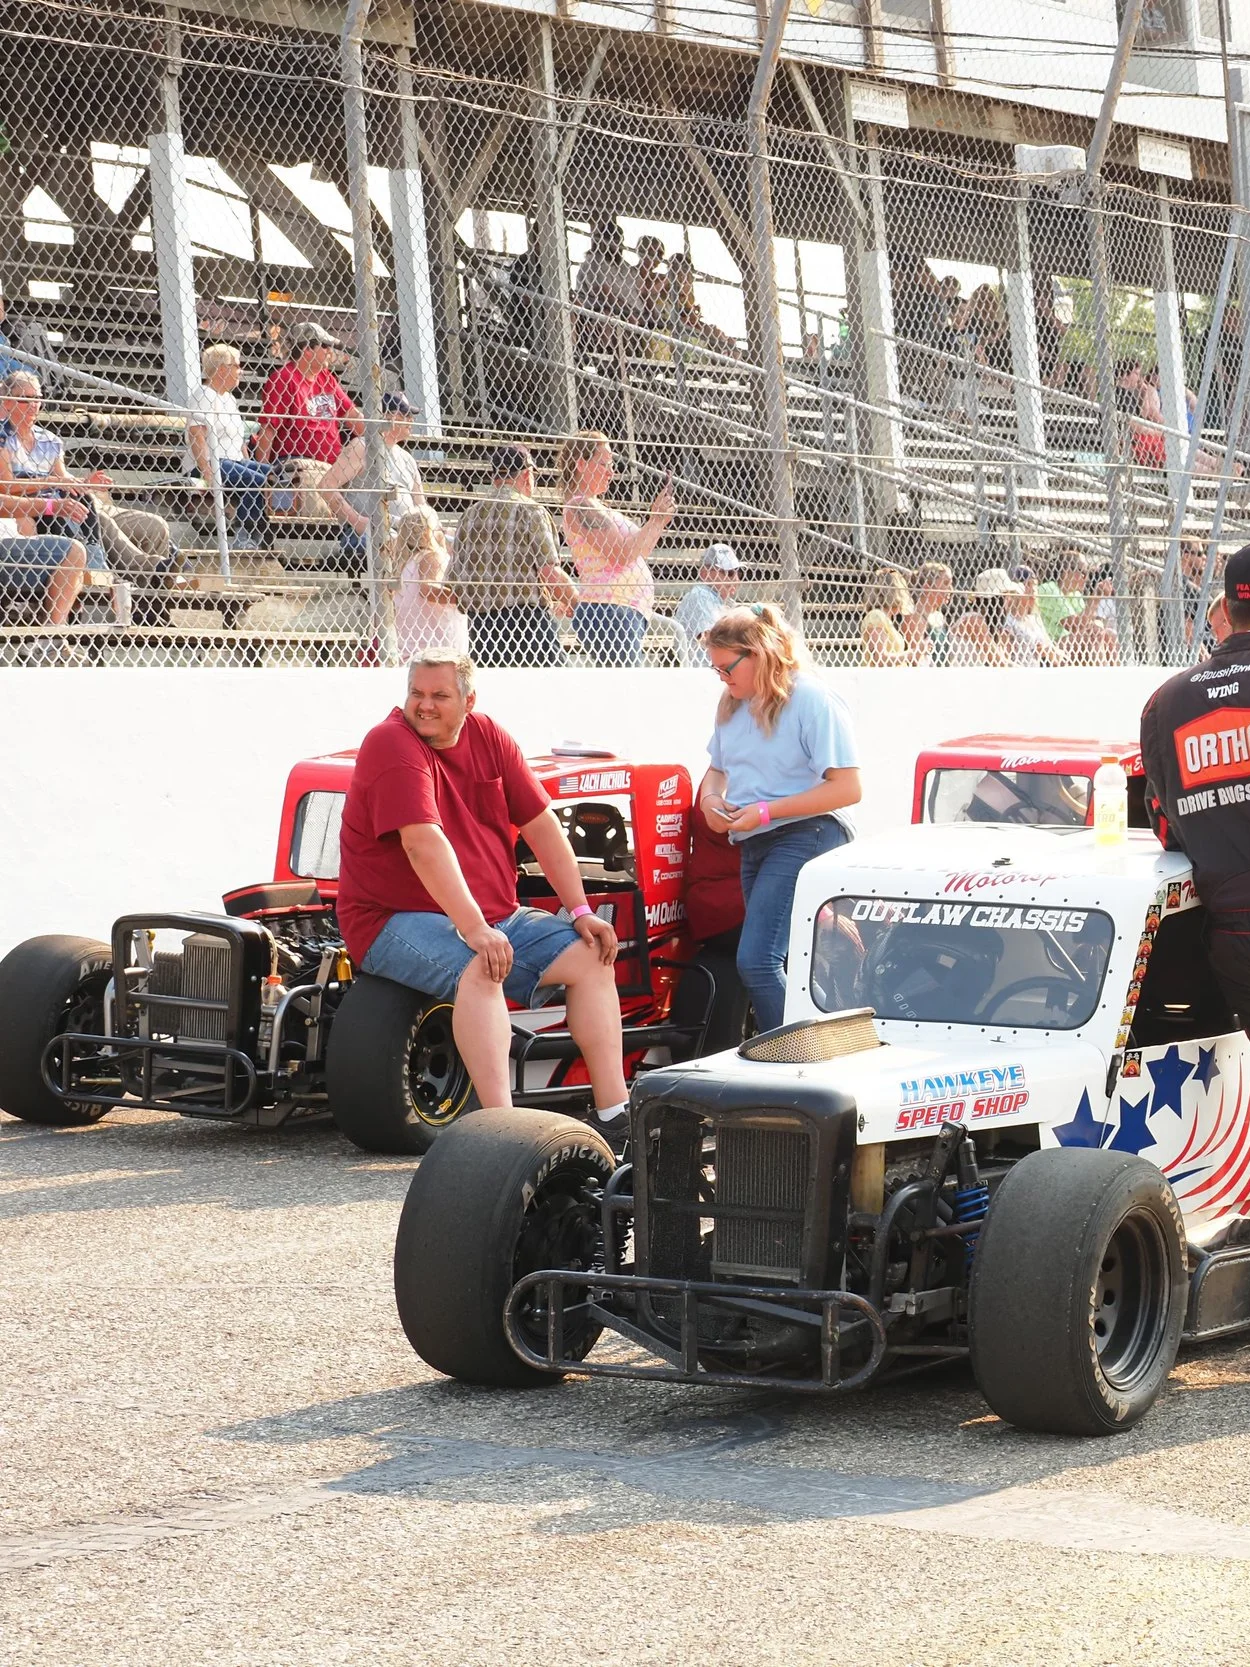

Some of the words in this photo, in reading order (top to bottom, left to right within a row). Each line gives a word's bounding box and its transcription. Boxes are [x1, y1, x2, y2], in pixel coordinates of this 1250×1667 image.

[1207, 682, 1239, 698] WING
[579, 773, 600, 790] ZACH
[599, 770, 631, 789] NICHOLS
[1177, 789, 1217, 816] DRIVE
[851, 900, 971, 927] OUTLAW
[969, 905, 1089, 932] CHASSIS
[900, 1063, 1026, 1106] HAWKEYE
[895, 1100, 966, 1132] SPEED
[970, 1091, 1030, 1120] SHOP
[521, 1143, 611, 1214] AMERICAN
[1159, 1186, 1189, 1272] RACER
